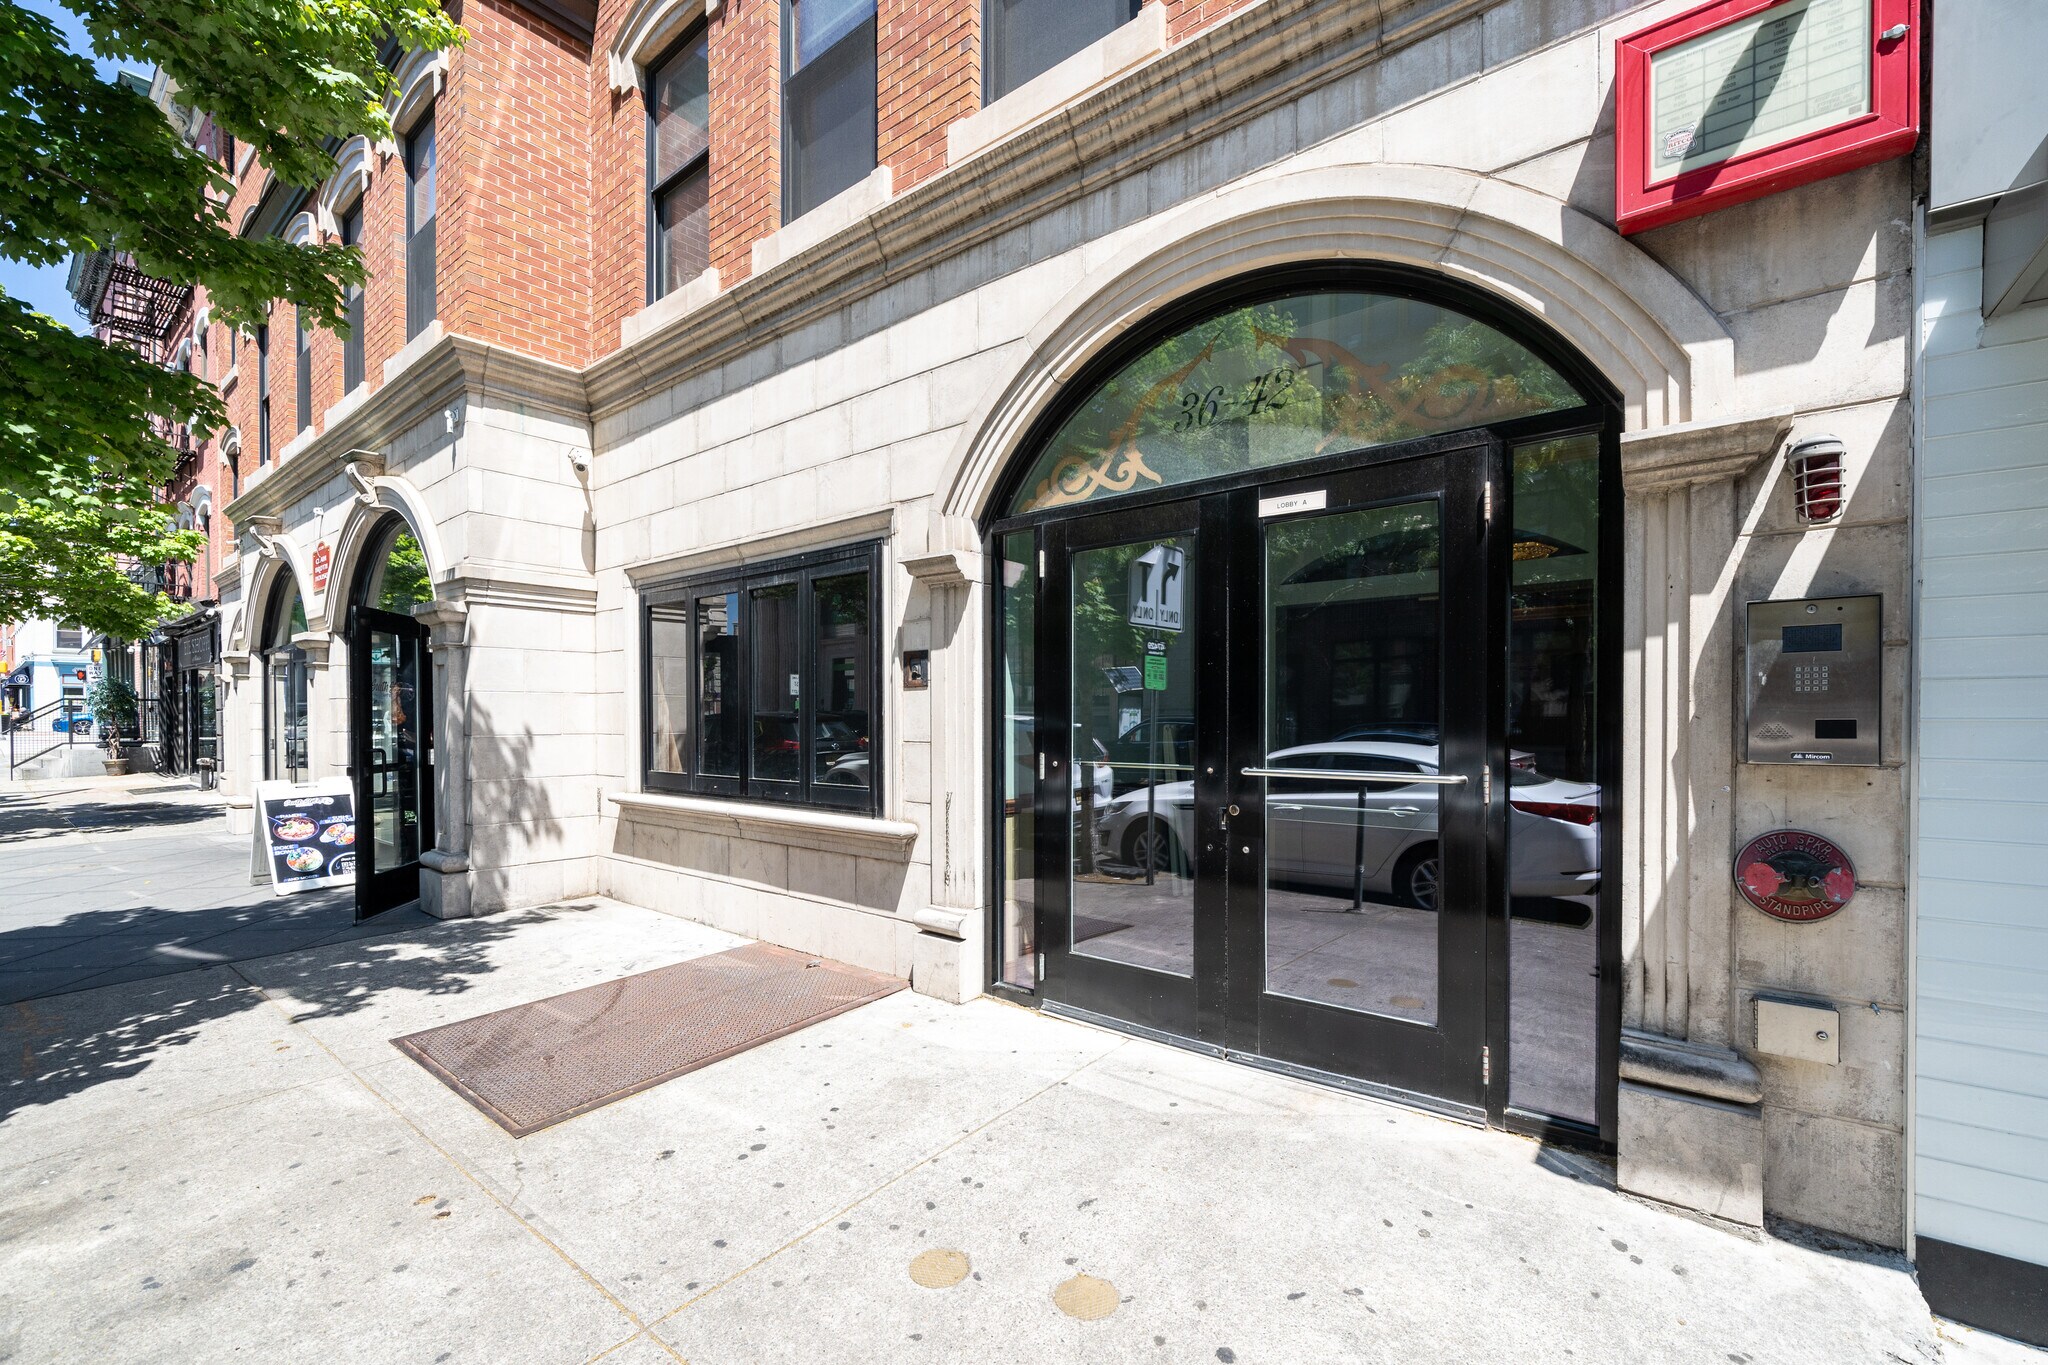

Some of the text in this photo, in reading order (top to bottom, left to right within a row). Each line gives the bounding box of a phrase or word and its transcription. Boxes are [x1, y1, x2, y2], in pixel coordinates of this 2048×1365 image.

[1173, 366, 1295, 434] 36-42
[1276, 500, 1298, 509] LOBBY
[1755, 834, 1787, 853] AUTO
[1760, 892, 1833, 916] STANDPIPE
